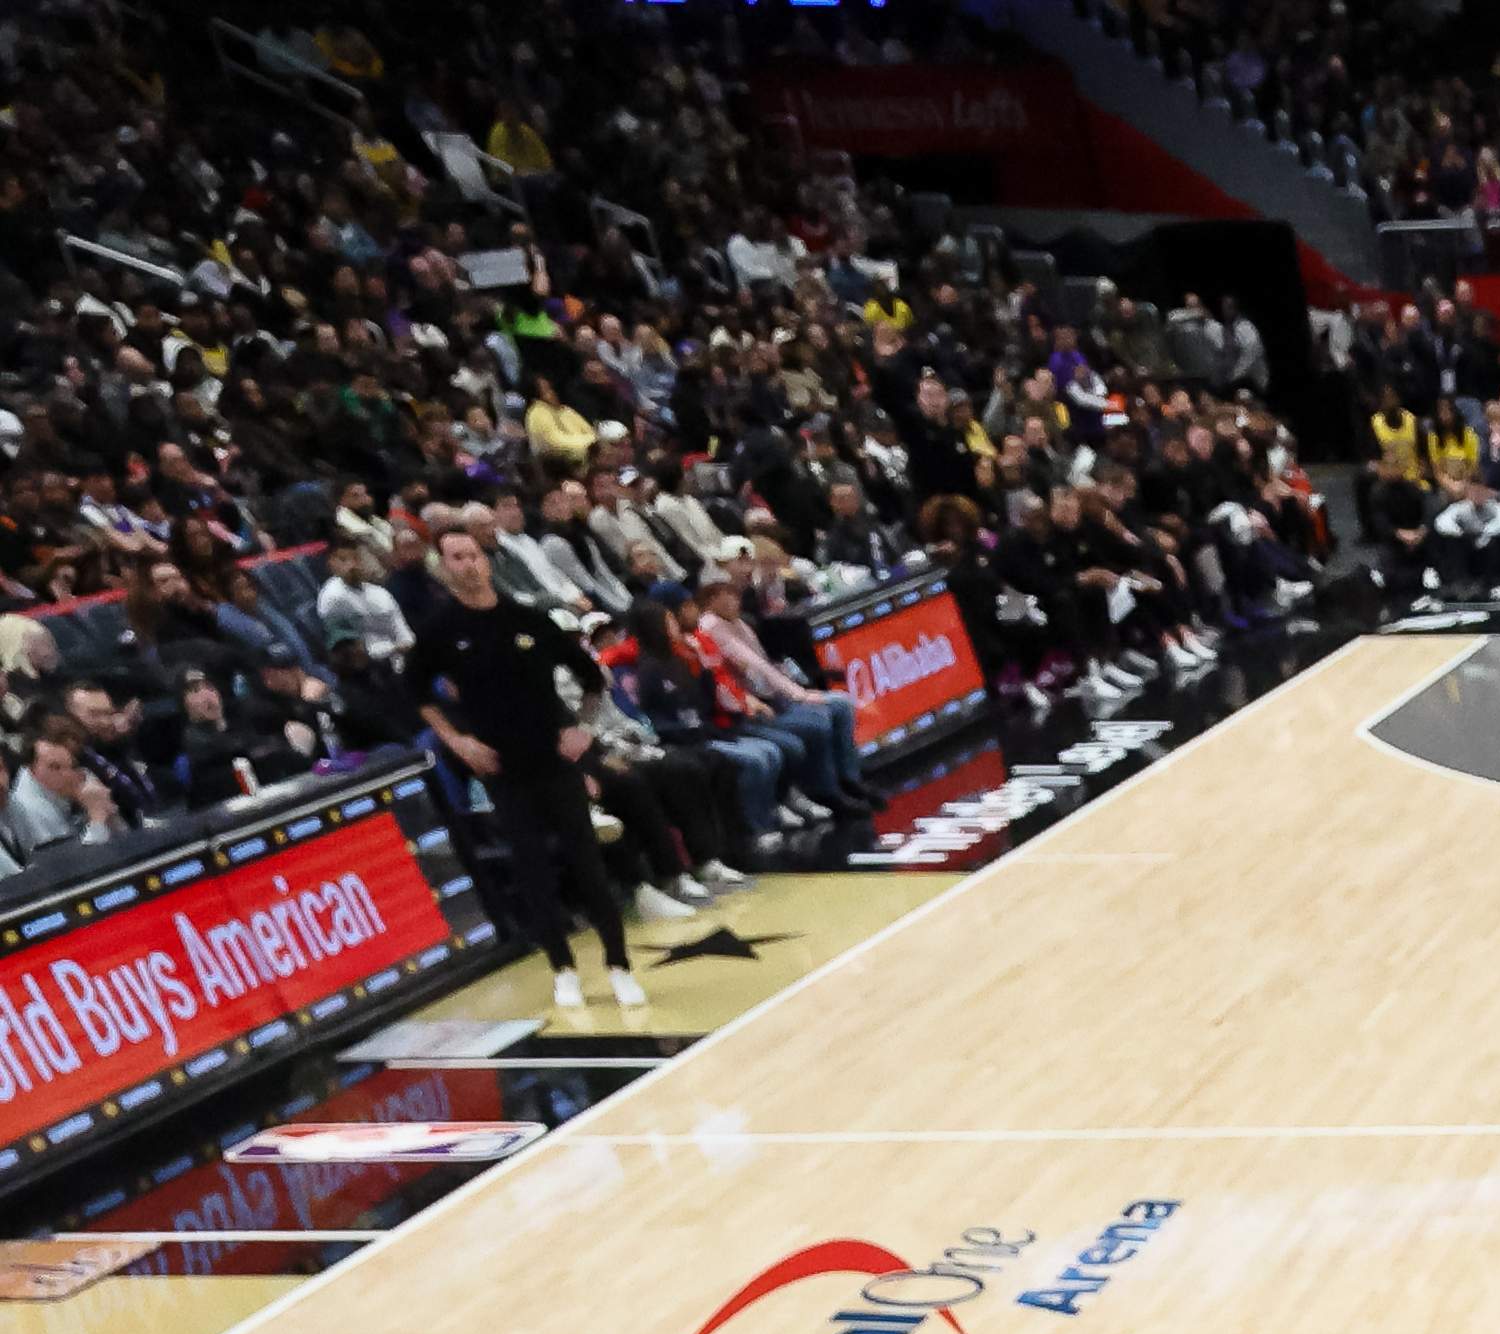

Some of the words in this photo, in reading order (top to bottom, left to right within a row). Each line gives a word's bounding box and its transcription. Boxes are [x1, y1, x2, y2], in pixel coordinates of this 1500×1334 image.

[49, 950, 197, 1056] Buys
[174, 871, 387, 1008] American
[1015, 1199, 1184, 1316] Arena
